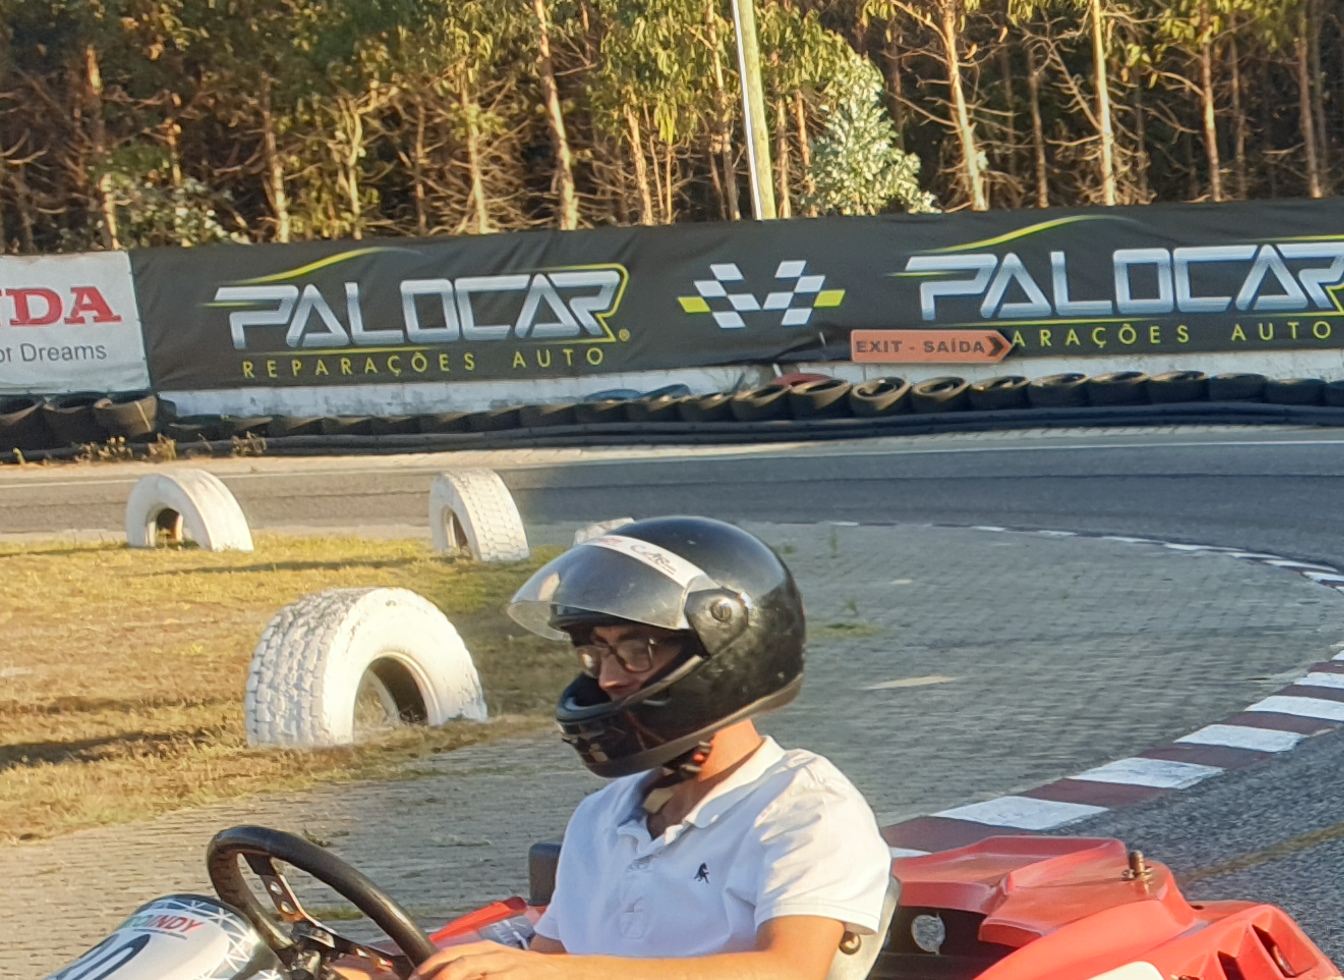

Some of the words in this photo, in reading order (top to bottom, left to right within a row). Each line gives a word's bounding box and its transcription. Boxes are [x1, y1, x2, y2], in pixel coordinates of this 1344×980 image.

[0, 286, 122, 326] DA
[214, 270, 621, 350] PALOCAR
[855, 340, 903, 353] EXIT
[922, 337, 986, 353] SAÍDA
[1011, 323, 1190, 349] ARAÇÕES
[1231, 320, 1333, 342] AUTO
[20, 342, 108, 362] Dreams
[242, 351, 477, 379] REPARAÇÕES
[512, 346, 604, 370] AUTO
